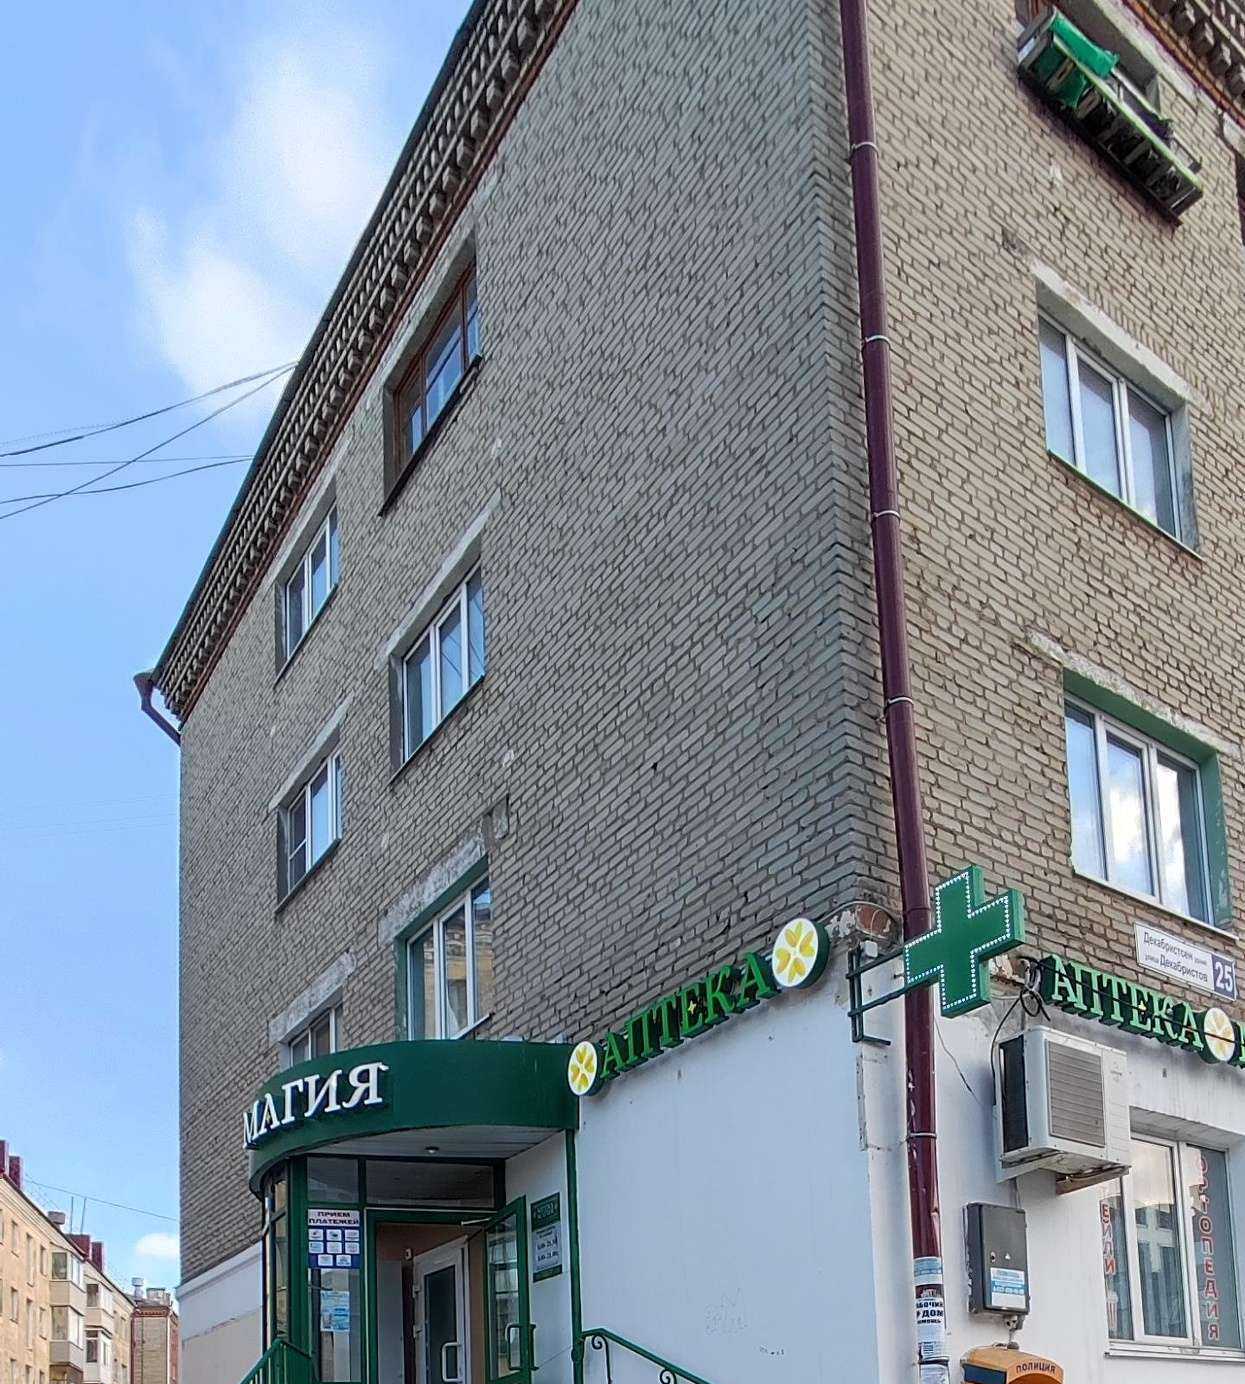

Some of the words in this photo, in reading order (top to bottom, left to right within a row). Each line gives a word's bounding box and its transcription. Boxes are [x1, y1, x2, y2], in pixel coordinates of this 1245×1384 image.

[1160, 954, 1208, 982] Декабристов
[1215, 962, 1234, 992] 25
[601, 951, 778, 1081] АПТЕКА
[1050, 953, 1204, 1052] АПТЕКА
[242, 1062, 389, 1149] МАГИЯ
[1015, 1361, 1056, 1374] ПОЛИЦИЯ
